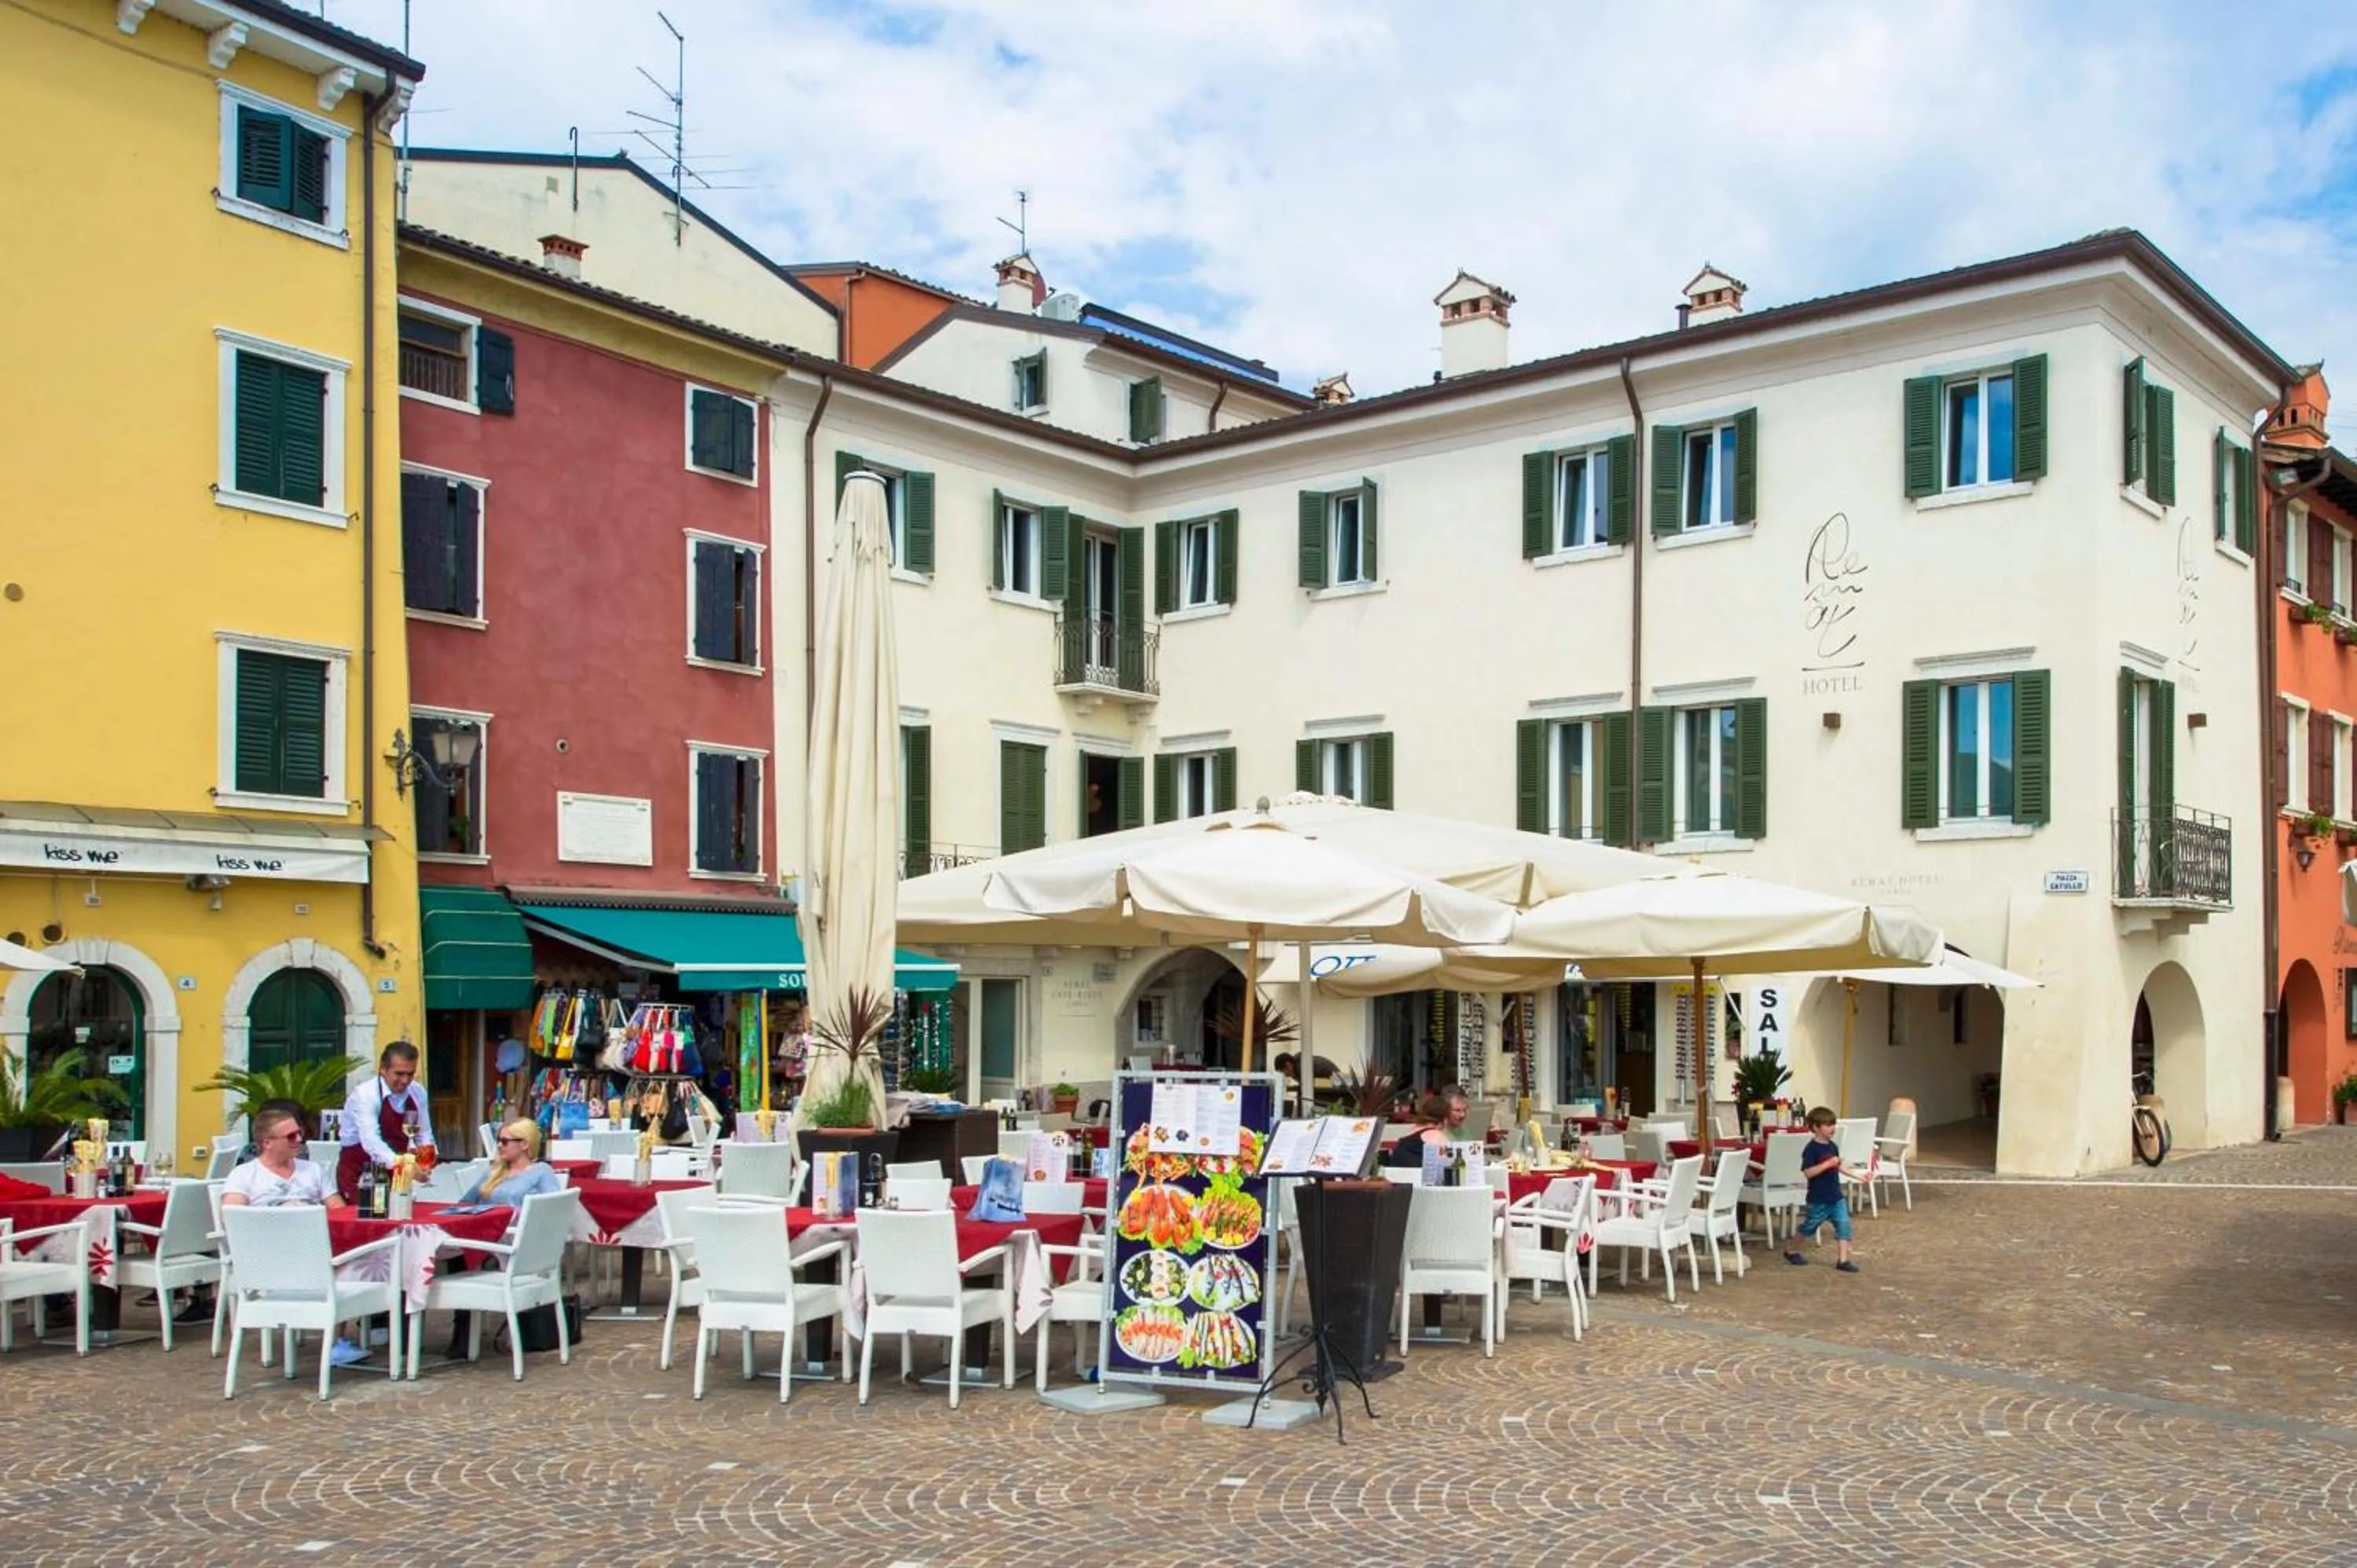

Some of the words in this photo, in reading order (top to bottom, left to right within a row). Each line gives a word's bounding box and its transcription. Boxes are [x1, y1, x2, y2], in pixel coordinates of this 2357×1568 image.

[1802, 675, 1864, 695] HOTEL
[44, 843, 82, 862] kiss
[87, 849, 119, 864] me
[216, 854, 251, 870] kiss
[253, 859, 283, 871] me
